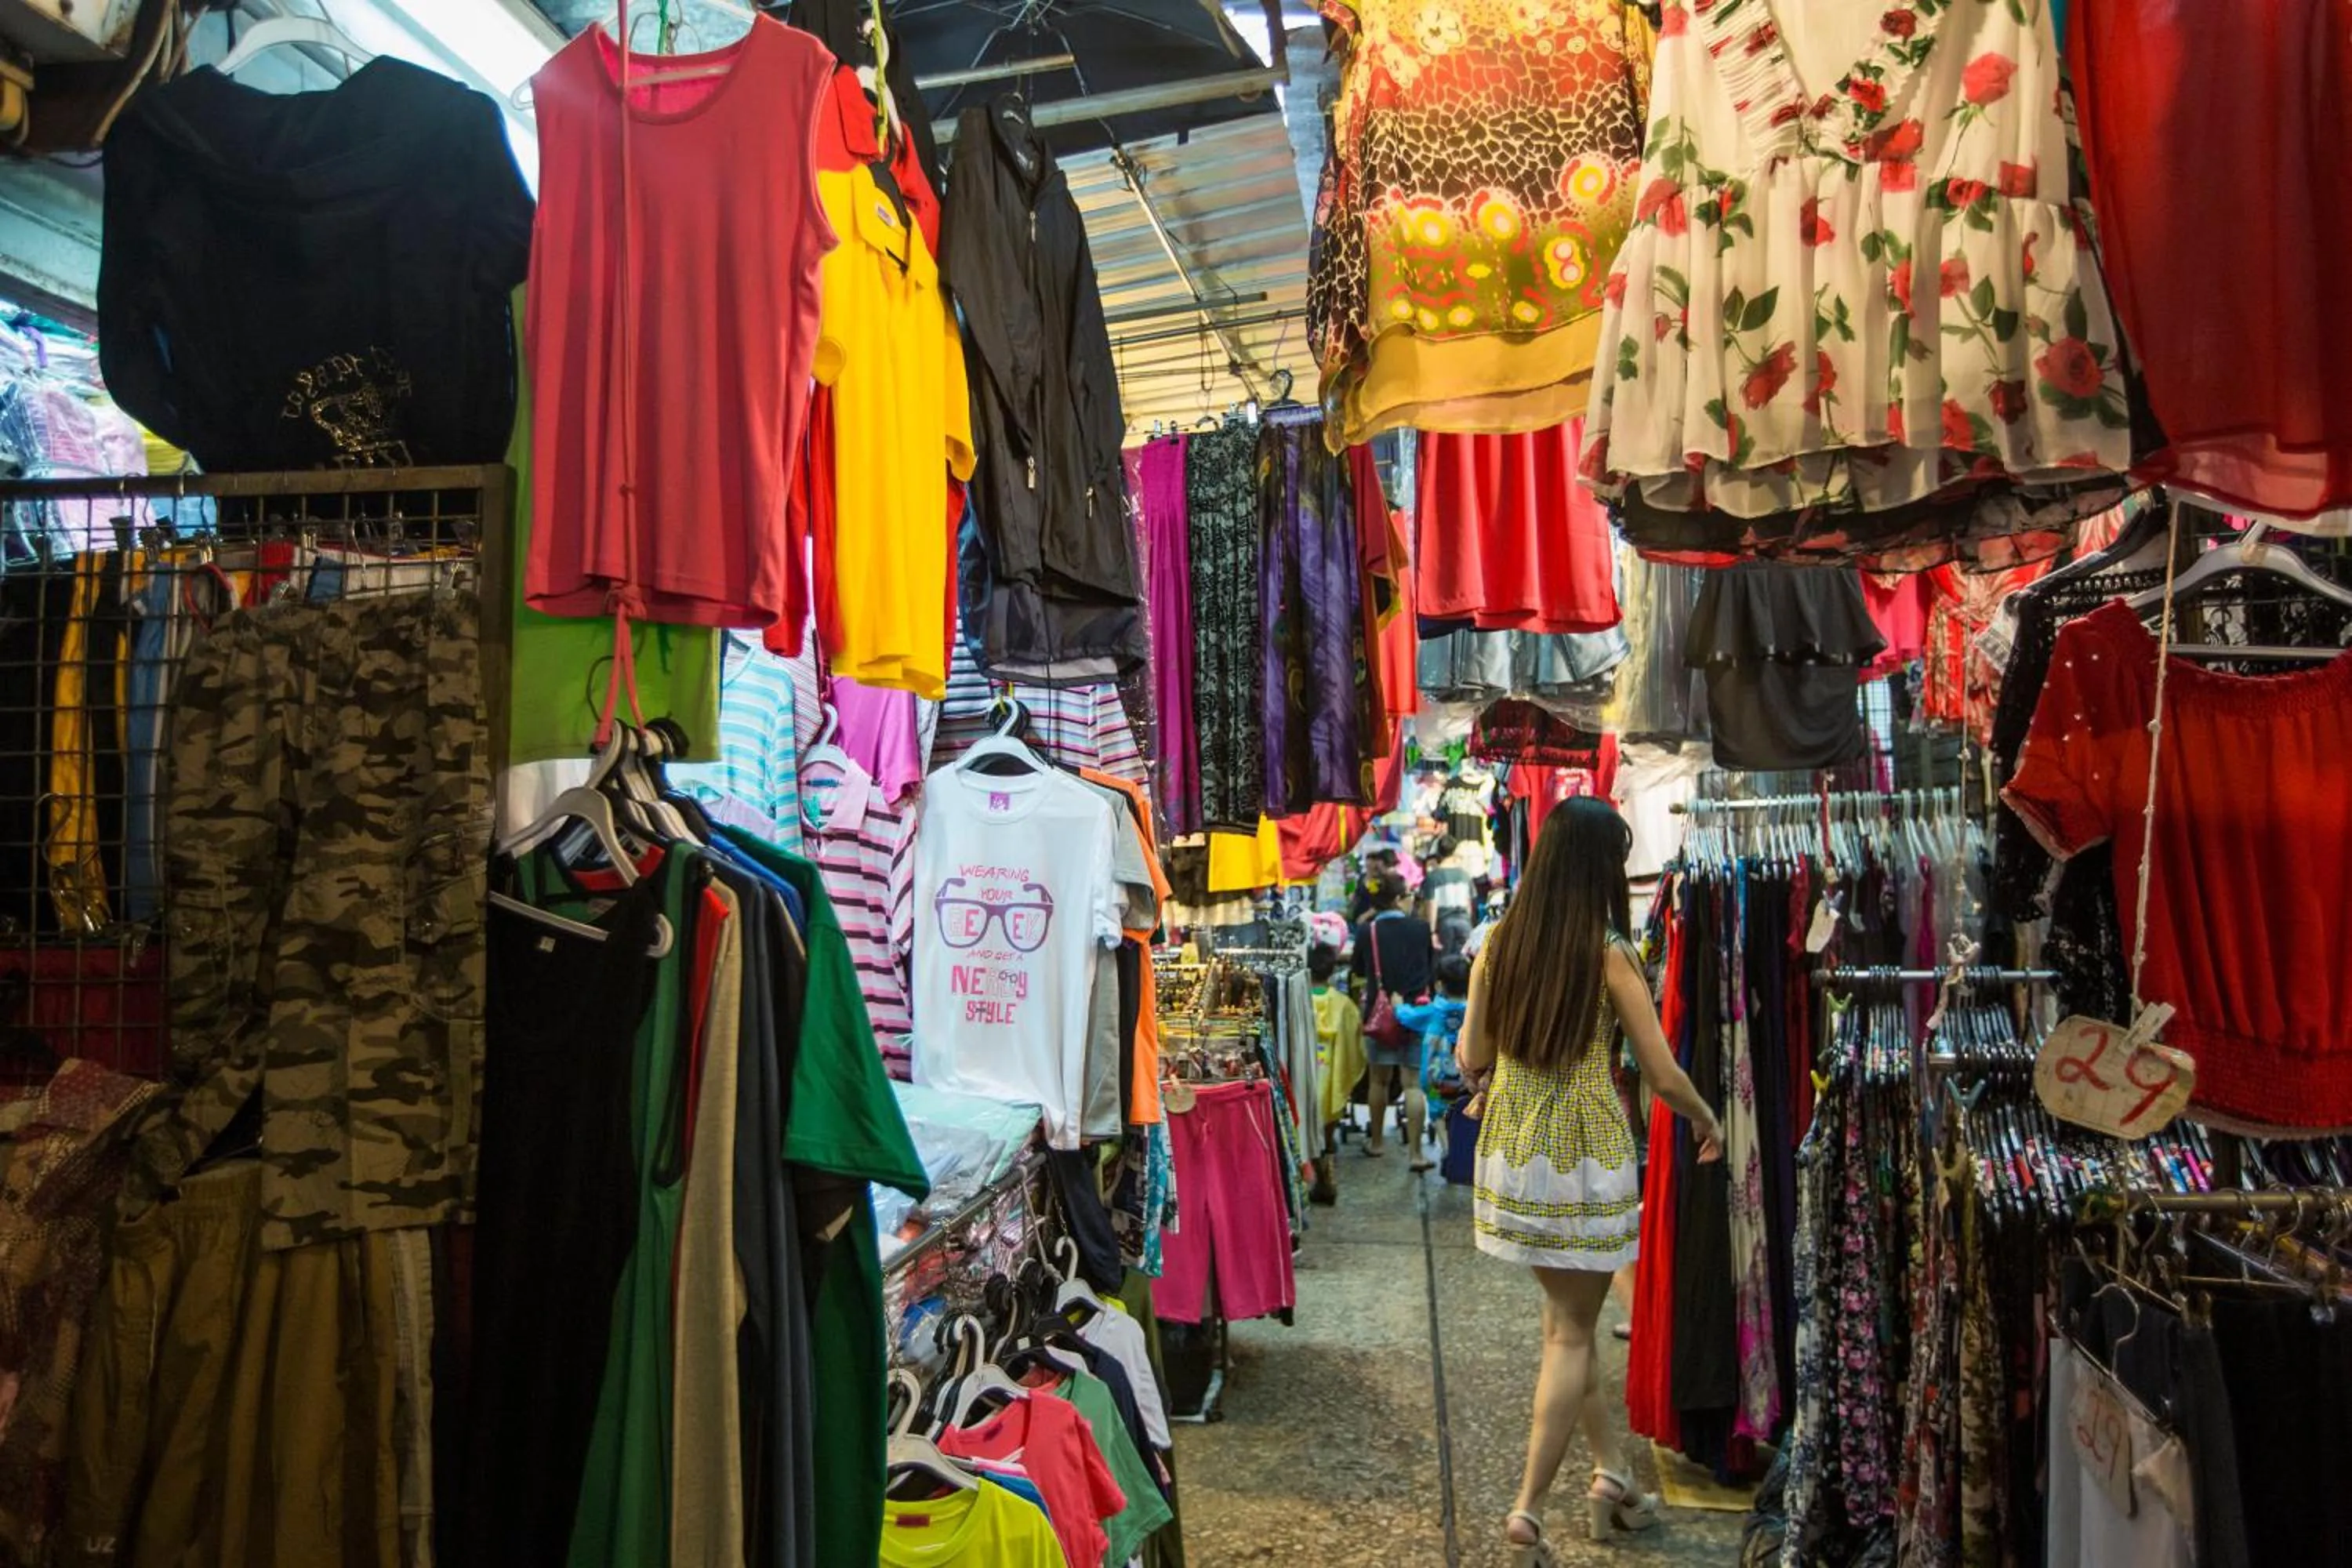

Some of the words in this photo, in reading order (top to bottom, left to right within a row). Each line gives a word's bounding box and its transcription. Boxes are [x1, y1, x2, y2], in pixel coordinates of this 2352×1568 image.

[960, 865, 1029, 882] WEARING
[980, 888, 1013, 902] YOUR
[966, 949, 993, 959] AND
[994, 951, 1016, 960] GET
[965, 1000, 1017, 1025] STYLE
[2055, 1025, 2179, 1127] 29
[2077, 1389, 2122, 1480] 29
